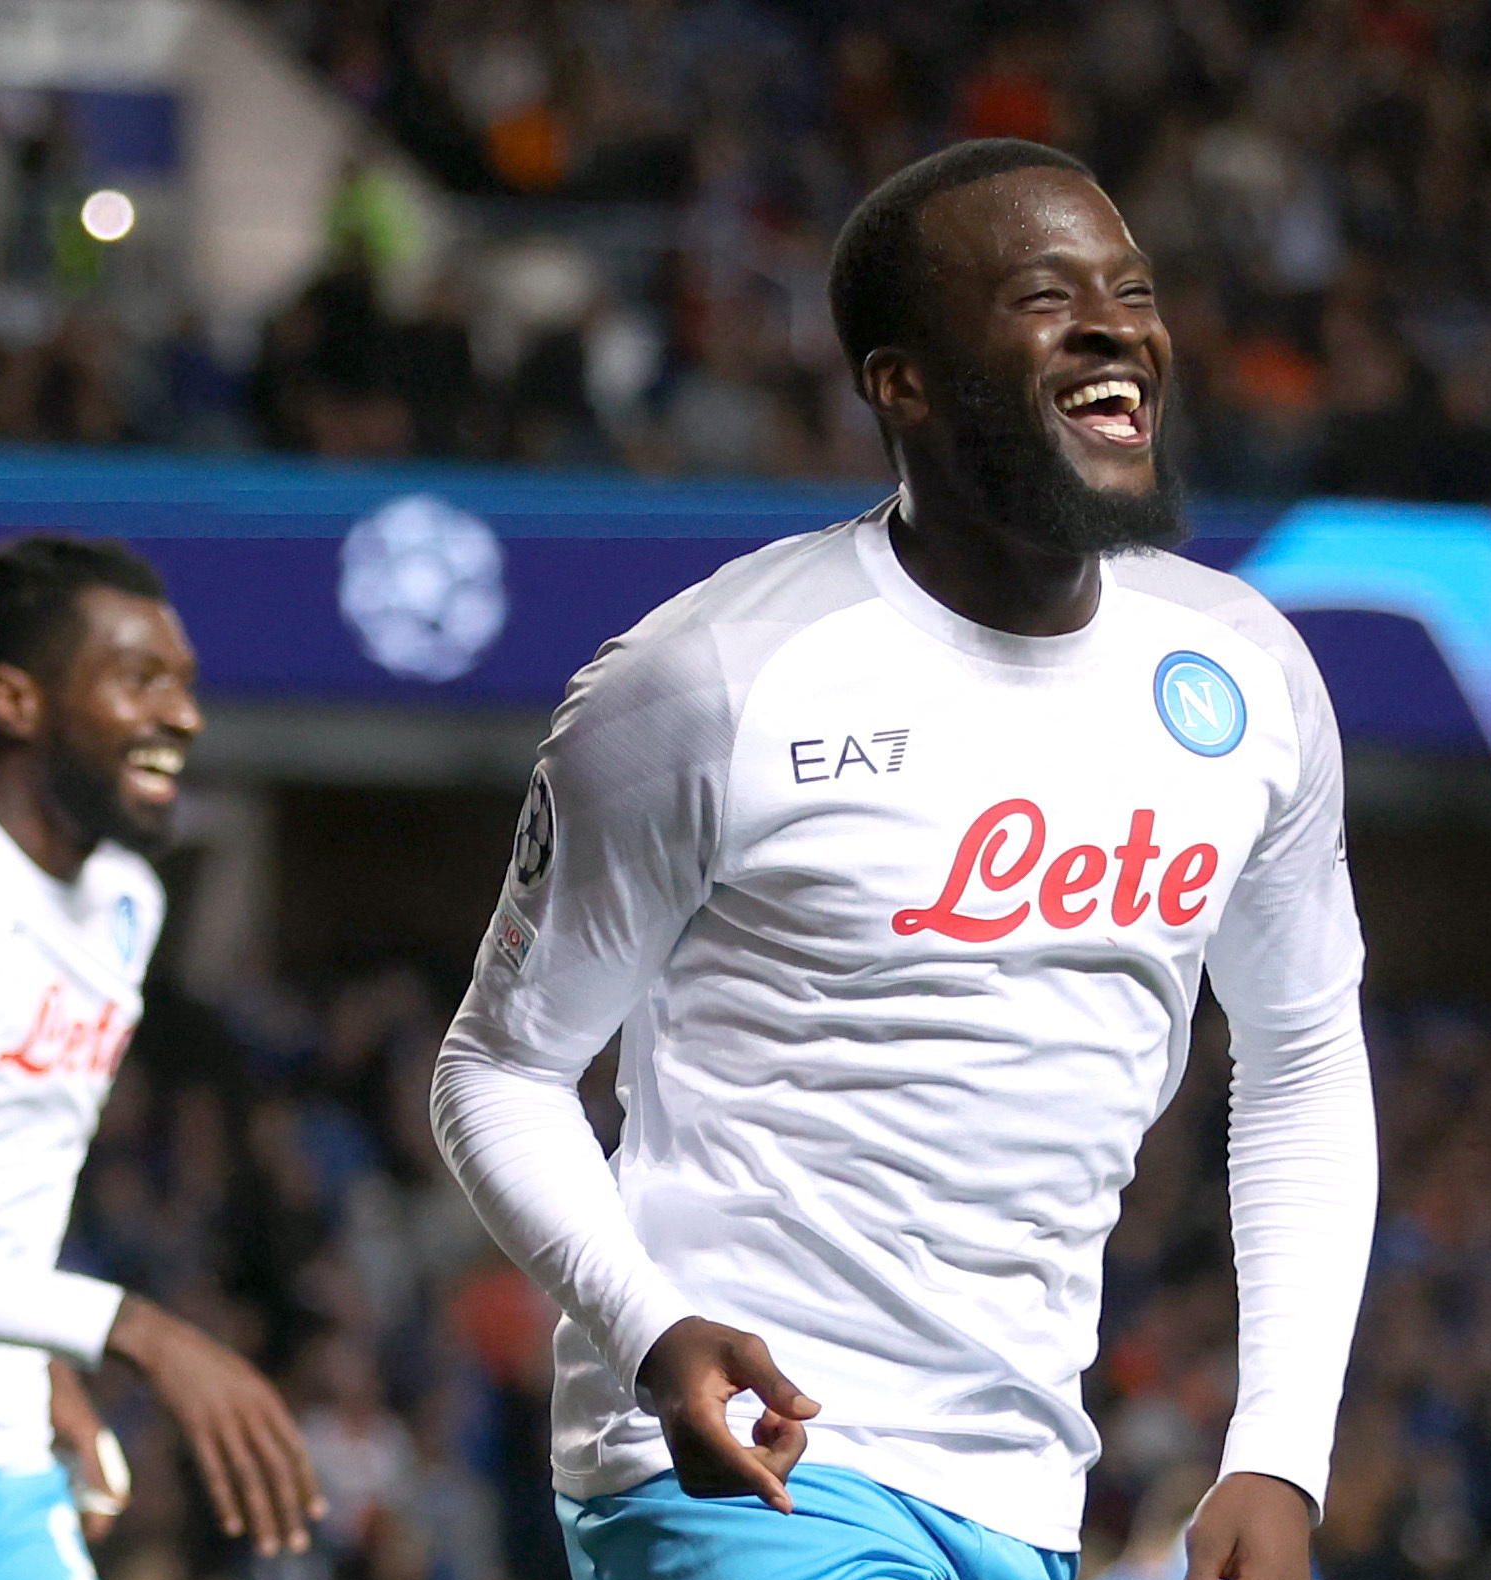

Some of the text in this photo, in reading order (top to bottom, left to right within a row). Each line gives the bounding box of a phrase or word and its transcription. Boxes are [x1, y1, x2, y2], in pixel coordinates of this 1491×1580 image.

[1173, 680, 1218, 729] N
[790, 728, 910, 784] EA7
[891, 798, 1218, 943] Lete
